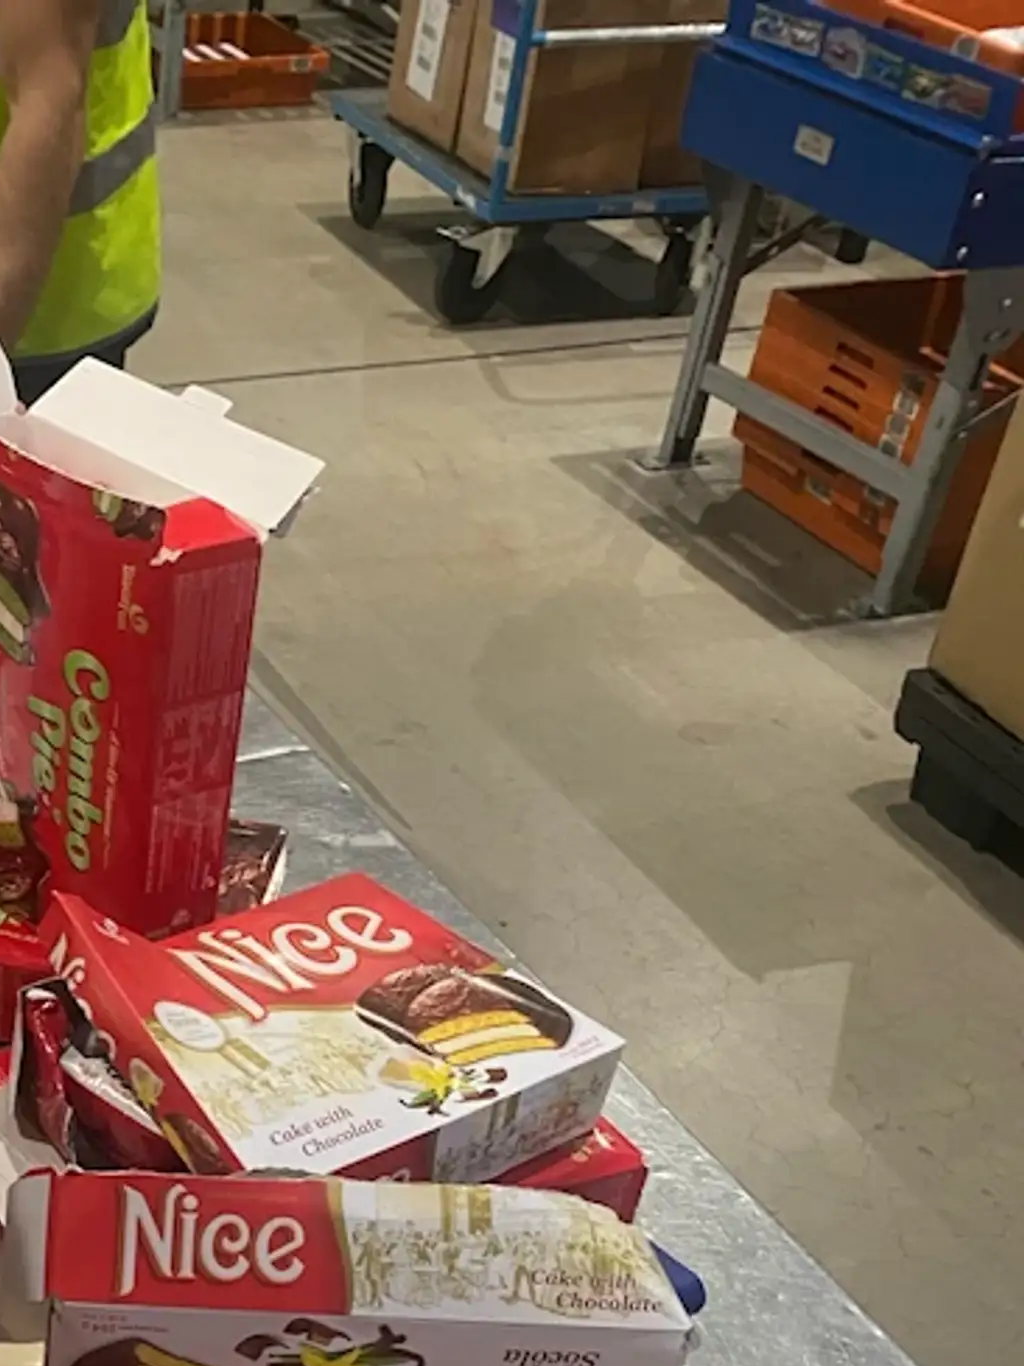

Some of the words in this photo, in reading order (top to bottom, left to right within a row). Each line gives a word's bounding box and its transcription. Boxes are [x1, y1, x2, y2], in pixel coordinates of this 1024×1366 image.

[28, 695, 65, 793] Pie
[64, 649, 110, 872] Combo
[168, 905, 414, 1024] Nice
[269, 1123, 324, 1146] Cake
[313, 1105, 355, 1130] with
[301, 1118, 385, 1157] Chocolate
[118, 1183, 306, 1296] Nice
[530, 1267, 584, 1289] Cake
[589, 1272, 638, 1294] with
[555, 1290, 665, 1314] Chocolate
